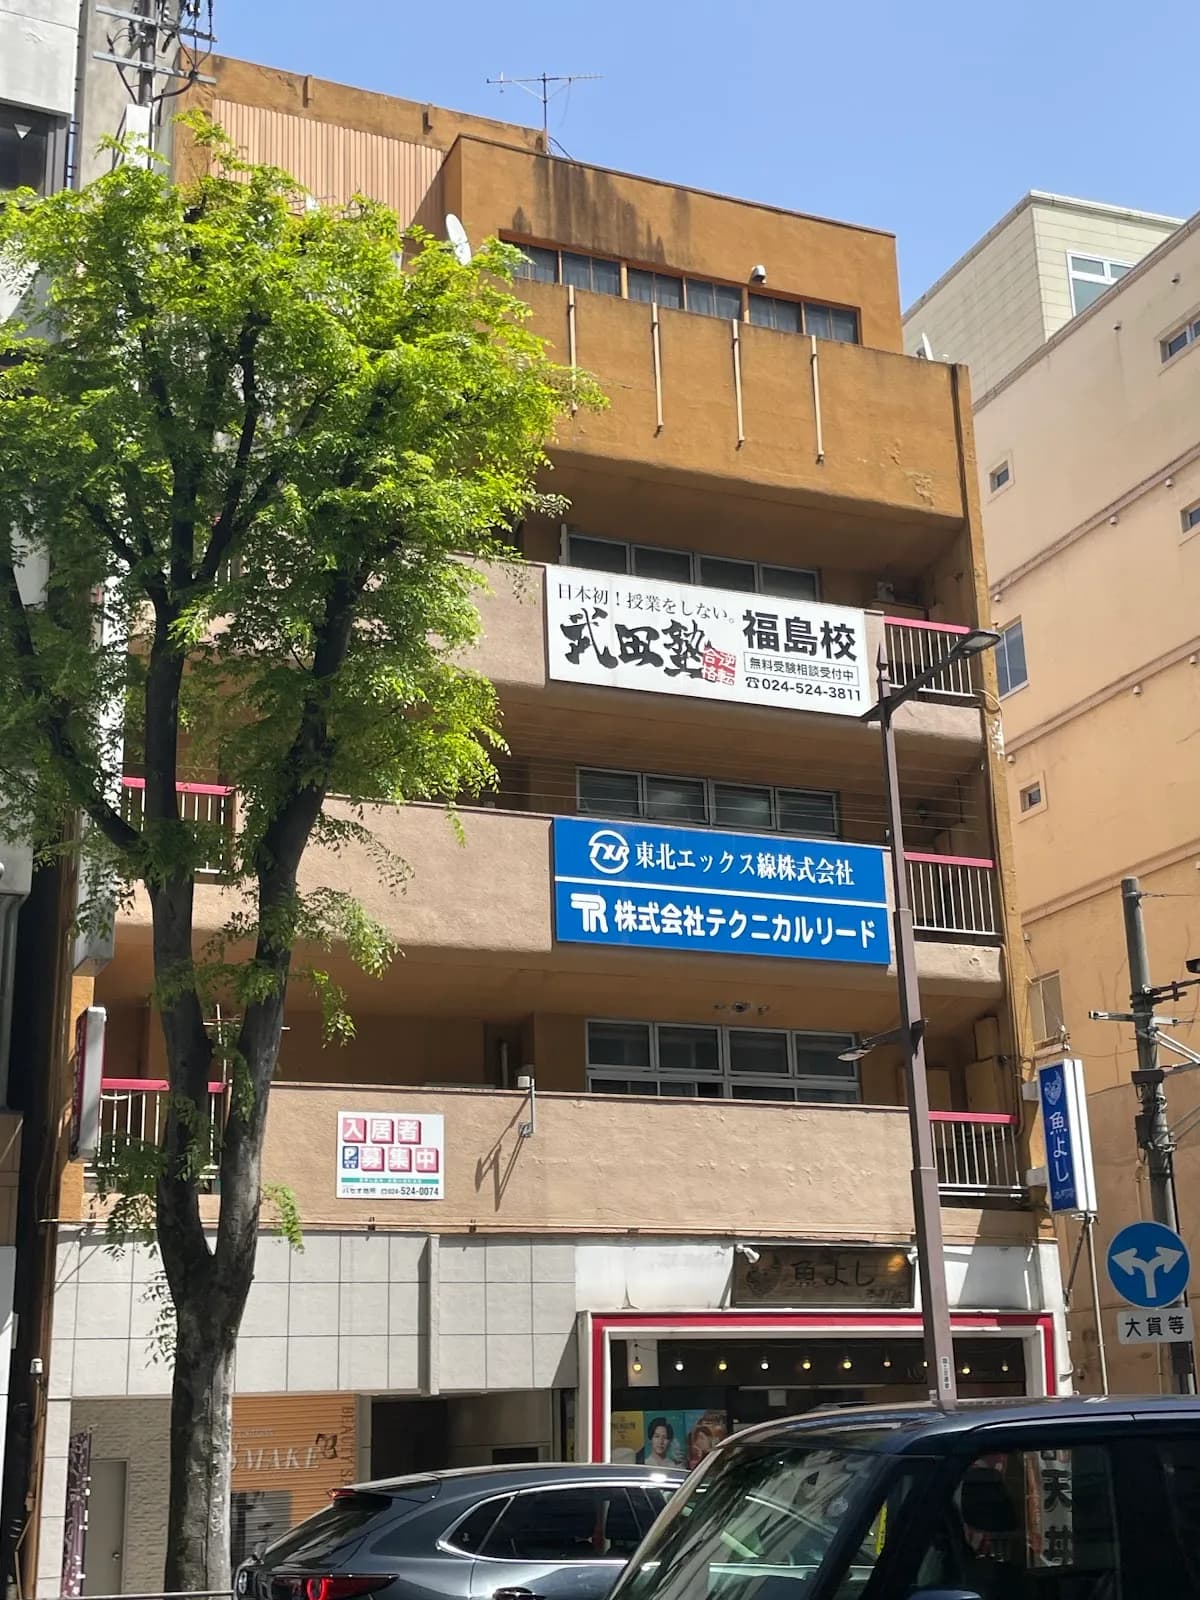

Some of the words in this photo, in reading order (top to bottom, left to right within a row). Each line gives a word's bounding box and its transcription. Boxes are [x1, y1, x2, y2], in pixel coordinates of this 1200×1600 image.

[558, 583, 735, 624] 日本初！授業をしない。
[559, 606, 711, 678] 武田塾
[742, 609, 857, 662] 福島校
[749, 656, 854, 681] 無料受験相談受付中
[762, 678, 861, 702] 024-524-3811
[634, 840, 855, 886] 東北エックス線株式会社
[614, 898, 876, 949] 株式会社テクニカルリード
[342, 1118, 419, 1142] 入居者
[1049, 1111, 1069, 1183] 魚よし
[1125, 1315, 1185, 1337] 大貨等
